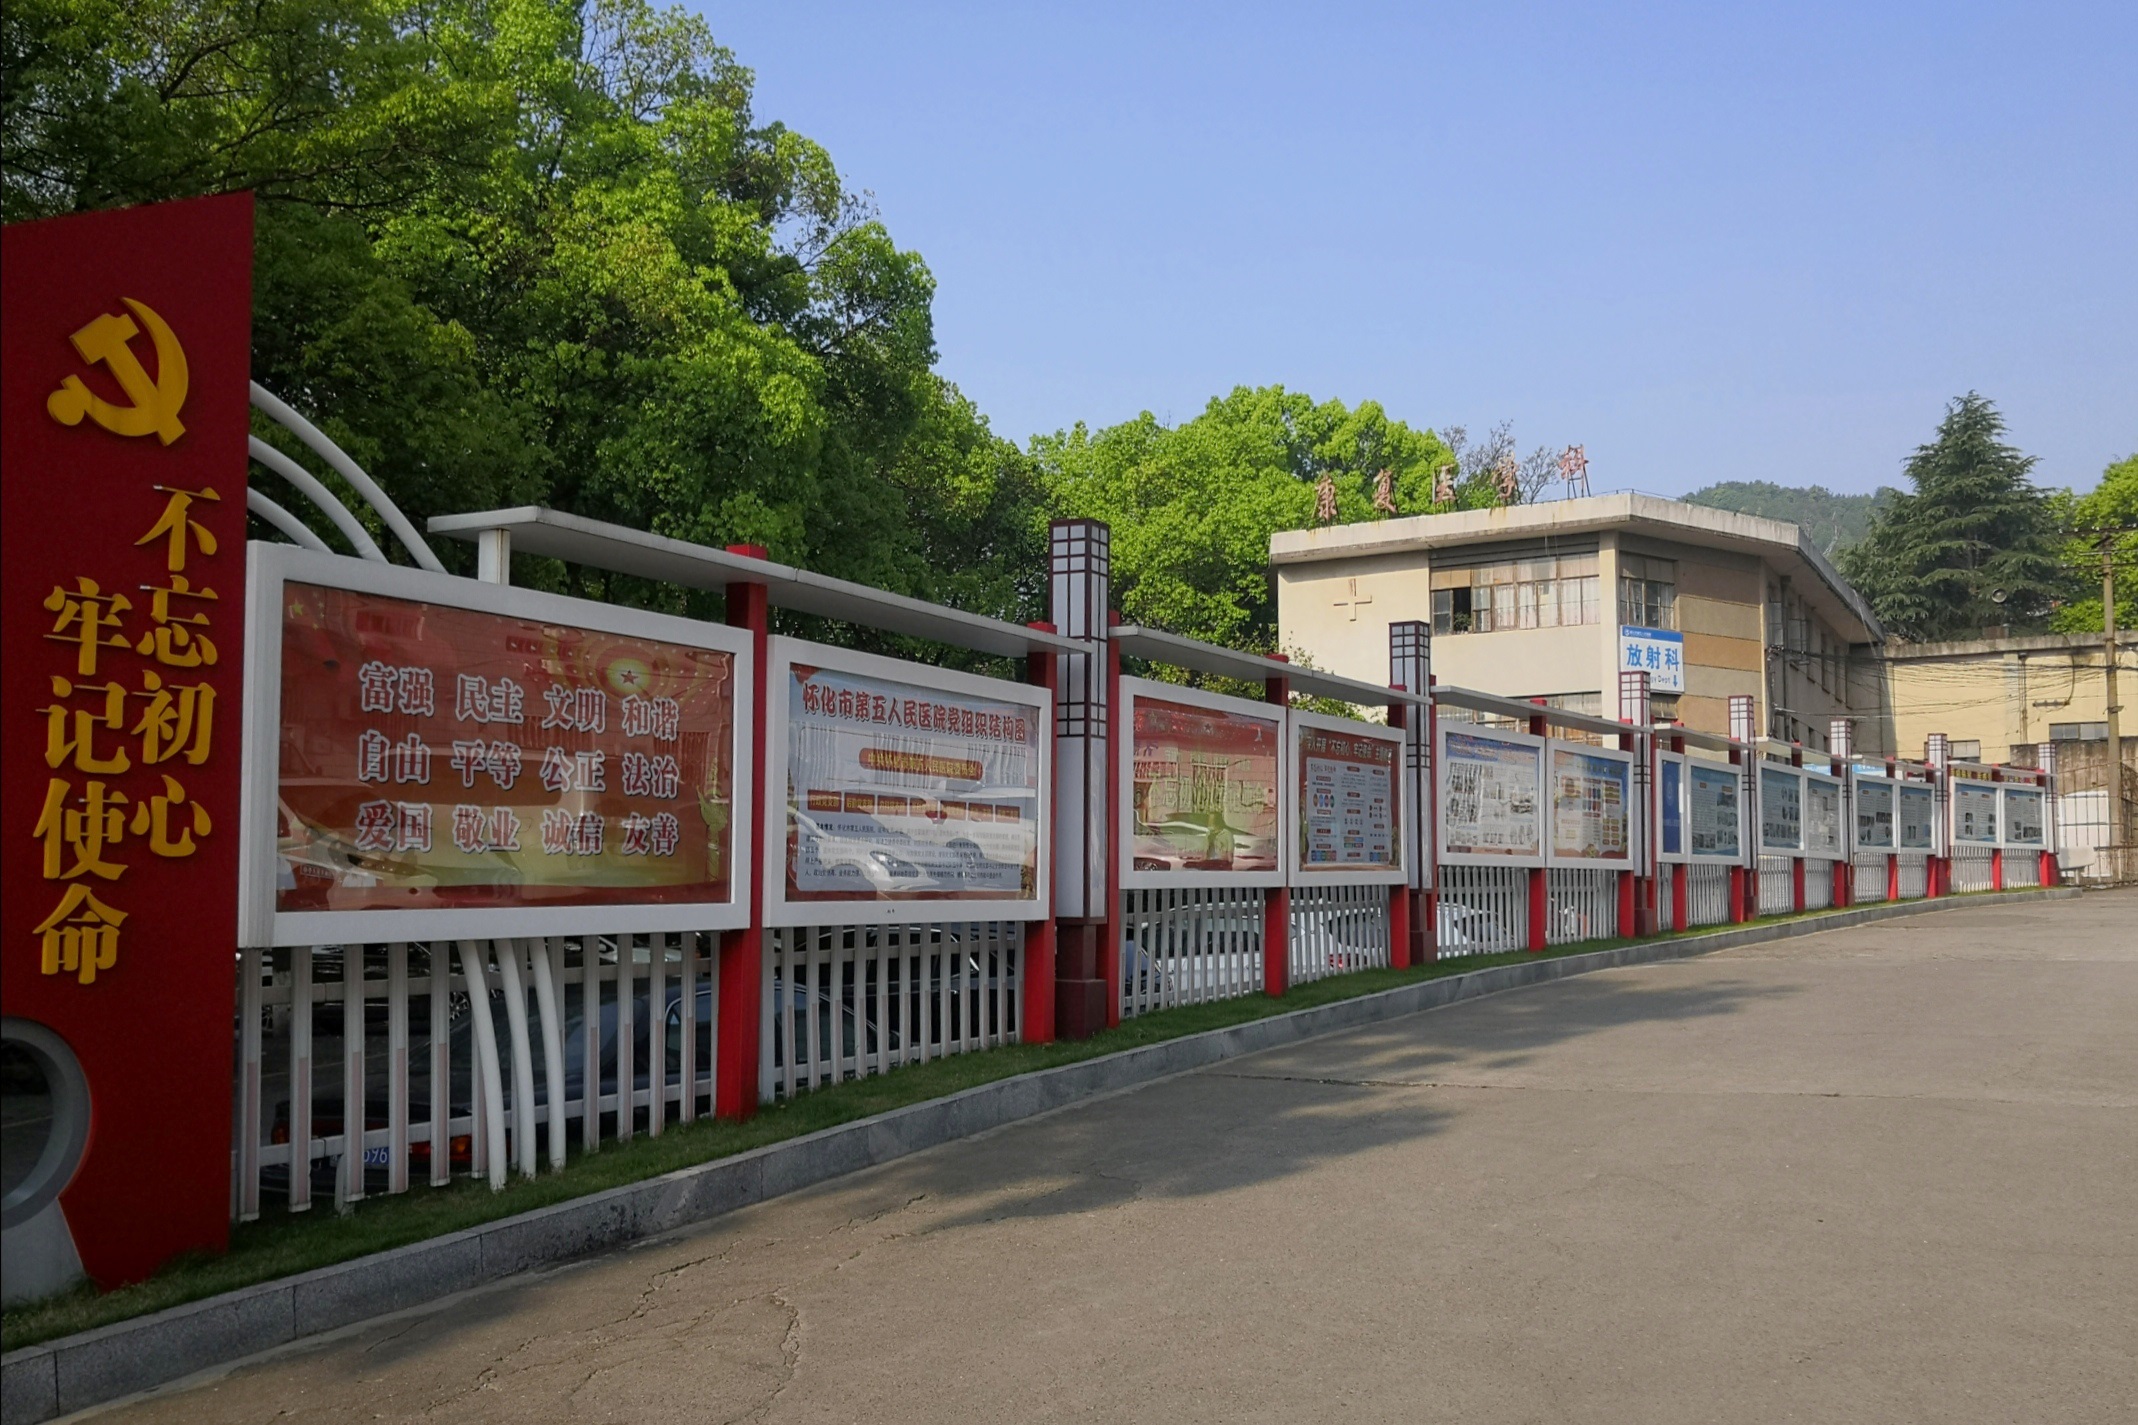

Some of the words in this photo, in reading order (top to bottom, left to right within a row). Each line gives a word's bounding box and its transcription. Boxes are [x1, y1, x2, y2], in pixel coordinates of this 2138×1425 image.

[130, 485, 221, 857] 不忘初心
[1627, 643, 1679, 672] 放射科
[359, 661, 434, 717] 富强
[455, 674, 523, 724] 民主
[542, 684, 606, 734] 文明
[622, 694, 679, 741] 和谐
[802, 682, 1027, 745] 怀化市第五人民医院党组织结构图
[33, 576, 131, 984] 牢记使命
[358, 730, 431, 784] 自由
[452, 739, 521, 790] 平等
[541, 747, 606, 793] 公正
[622, 753, 679, 798] 法治
[356, 800, 432, 853] 爱国
[453, 805, 521, 854] 敬业
[541, 809, 605, 856] 诚信
[621, 812, 679, 855] 友善
